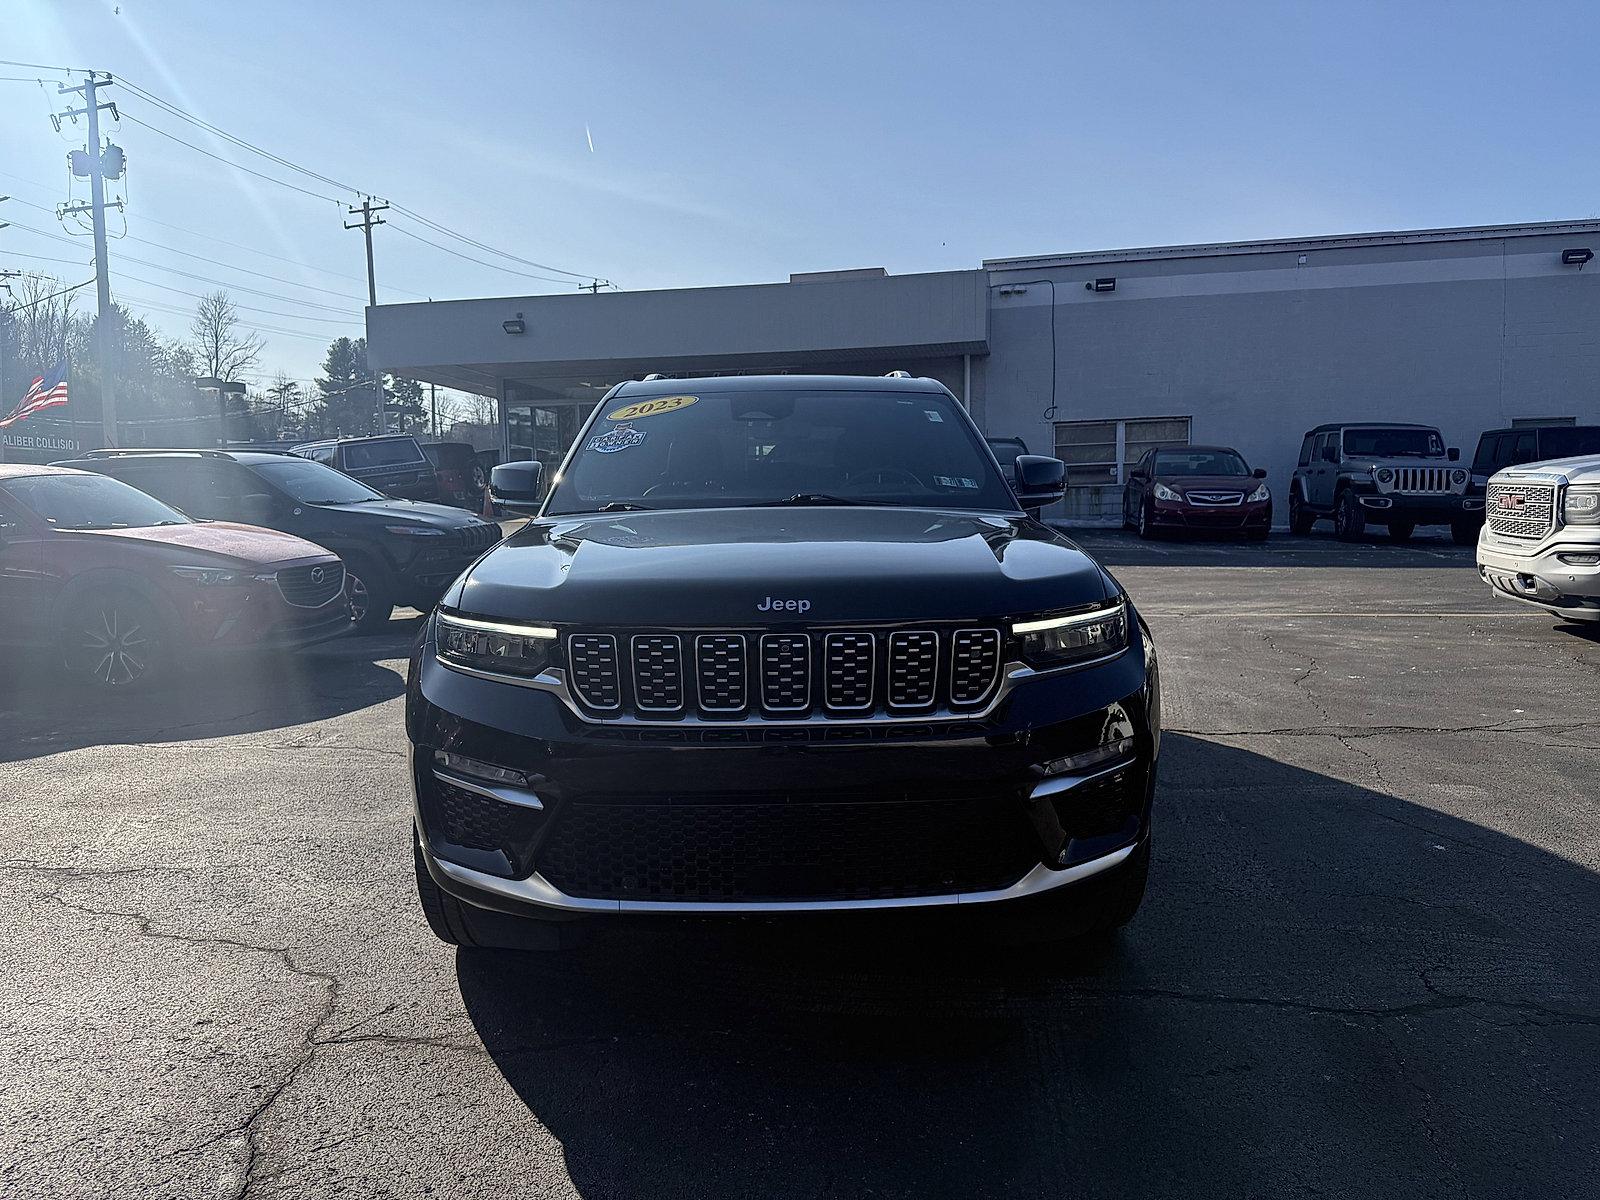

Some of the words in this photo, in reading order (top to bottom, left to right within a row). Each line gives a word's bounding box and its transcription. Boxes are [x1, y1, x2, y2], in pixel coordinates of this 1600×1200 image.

[624, 398, 682, 417] 2023
[2, 434, 34, 447] ALIBER
[1498, 494, 1524, 509] GMC
[757, 597, 811, 613] Jeep
